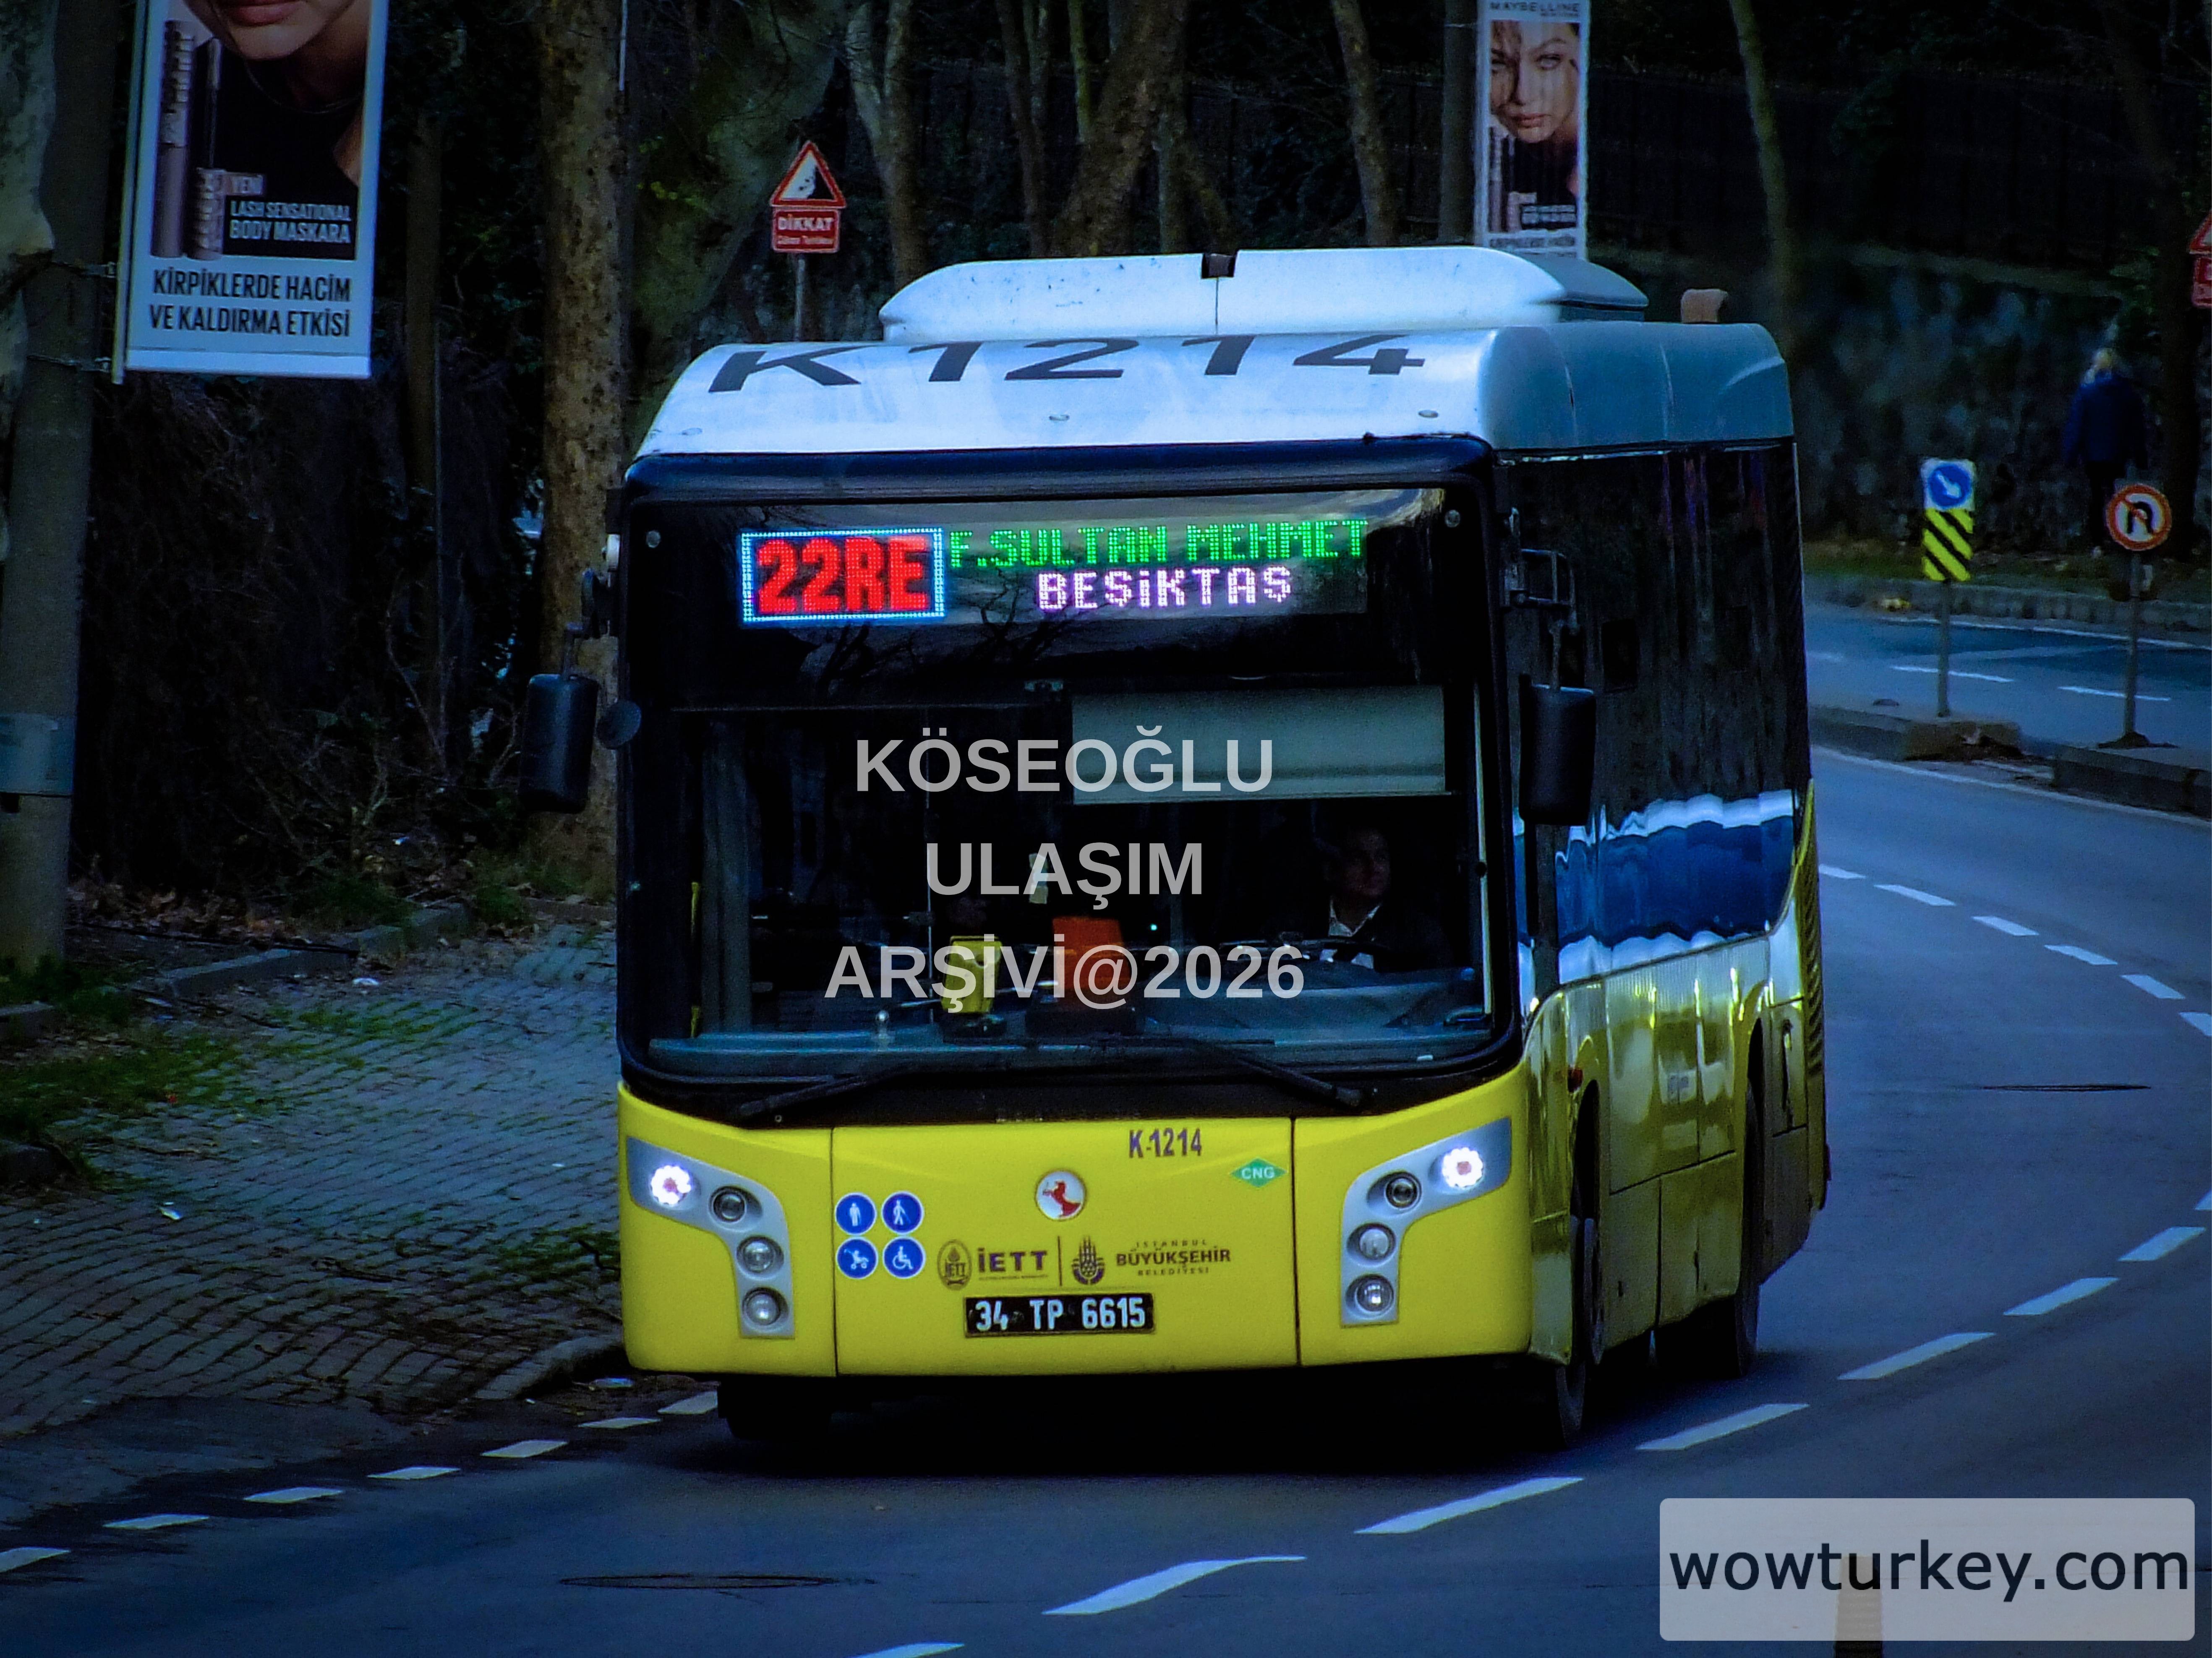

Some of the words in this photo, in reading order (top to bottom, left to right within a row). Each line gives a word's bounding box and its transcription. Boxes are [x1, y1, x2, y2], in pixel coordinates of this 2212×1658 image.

[230, 219, 272, 240] BODY
[274, 221, 351, 243] MASKARA
[154, 266, 282, 300] KİRPİKLERDE
[286, 274, 352, 302] HACİM
[150, 304, 175, 330] VE
[178, 305, 281, 334] KALDIRMA
[287, 308, 351, 337] ETKİSİ
[709, 334, 1426, 393] K1214
[950, 526, 1167, 567] F.SULTAN
[1186, 520, 1368, 561] MEHMET
[757, 536, 928, 613] 22RE
[1129, 1127, 1202, 1158] K-1214
[1241, 1166, 1275, 1180] CNG
[977, 1247, 1047, 1272] İETT
[1116, 1246, 1231, 1268] BÜYÜKŞEHİR
[974, 1300, 1008, 1331] 34
[1029, 1299, 1064, 1330] TP
[1081, 1297, 1145, 1329] 6615
